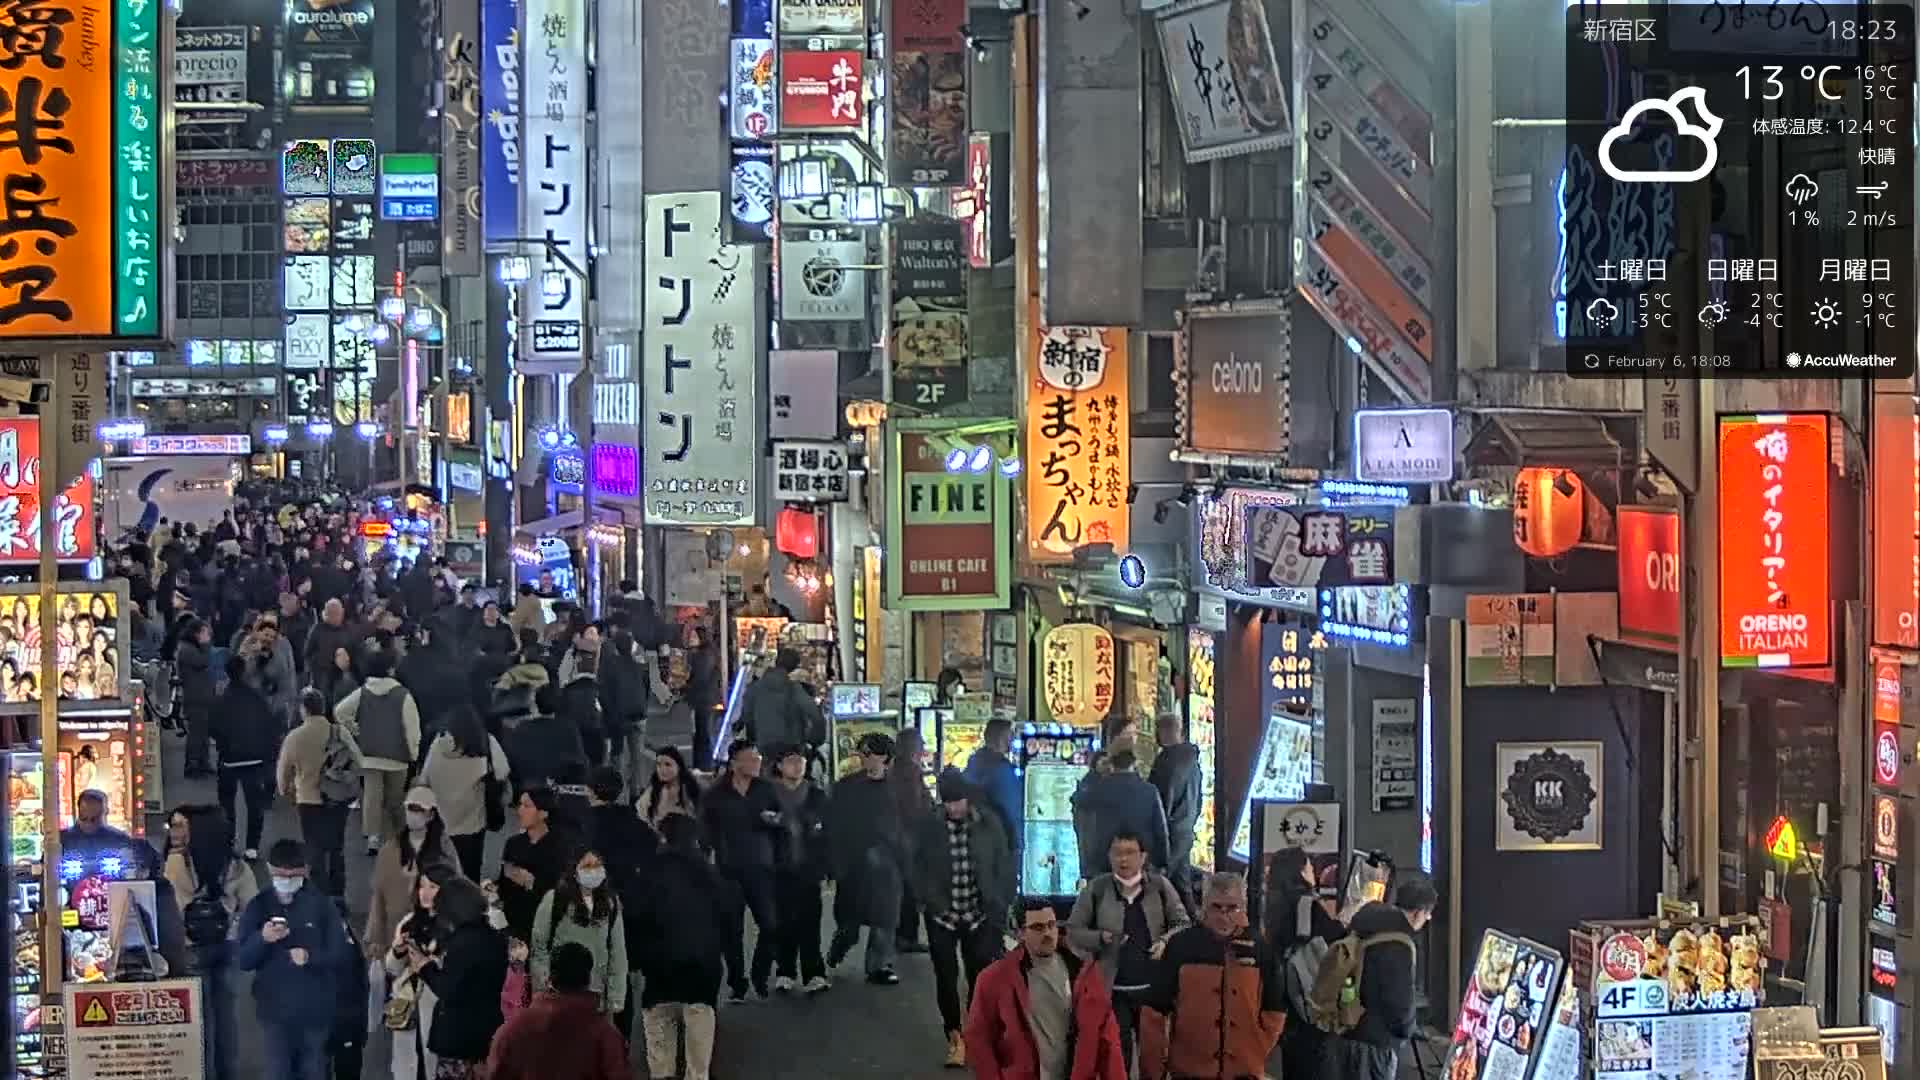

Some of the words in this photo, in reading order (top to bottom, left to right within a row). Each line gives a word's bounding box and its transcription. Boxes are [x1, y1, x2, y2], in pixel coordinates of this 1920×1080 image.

[77, 5, 101, 72] hanbey
[828, 57, 859, 120] 牛門
[1313, 72, 1334, 91] 4
[1314, 121, 1335, 141] 3
[386, 179, 435, 190] FamilyMart
[912, 169, 949, 182] 3F
[1312, 171, 1334, 190] 2
[900, 255, 958, 269] Walton's
[659, 207, 692, 462] トントン
[1212, 352, 1262, 393] celona
[71, 352, 92, 444] 通り一番街
[916, 383, 946, 403] 2F
[779, 448, 844, 470] 酒場心
[1040, 394, 1085, 543] まっちゃん
[778, 474, 845, 493] 新宿本店
[911, 483, 985, 513] FINE
[1350, 517, 1389, 533] フリー
[1754, 429, 1789, 603] 俺のイタリアン
[1303, 515, 1388, 578] 麻雀
[910, 560, 952, 573] ONLINE
[957, 559, 988, 572] CAFE
[1739, 614, 1808, 633] ORENO
[1739, 633, 1808, 650] ITALIAN
[1535, 780, 1563, 797] KK
[1602, 987, 1637, 1009] 4F
